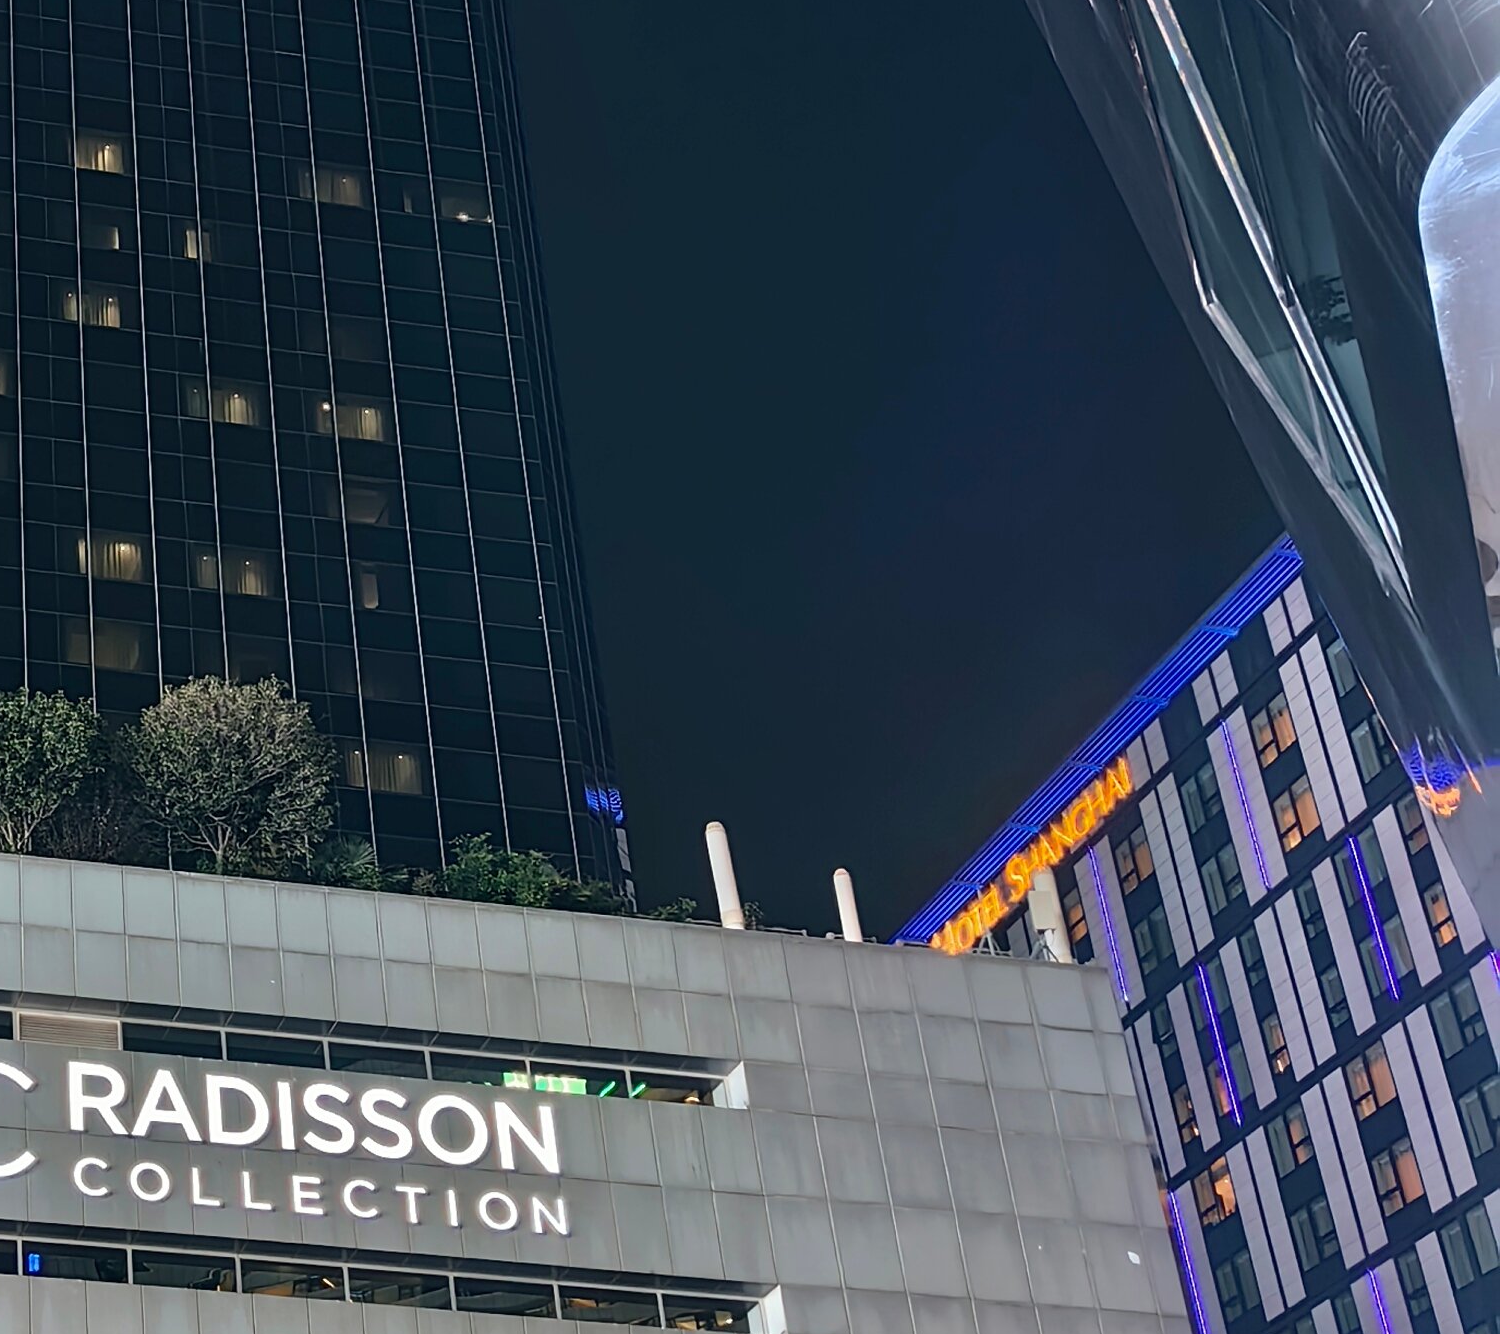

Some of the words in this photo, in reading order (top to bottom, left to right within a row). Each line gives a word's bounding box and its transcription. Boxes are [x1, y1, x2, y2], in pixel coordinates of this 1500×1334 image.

[1004, 756, 1135, 904] SHANGHAI
[67, 1060, 562, 1175] RADISSON
[72, 1156, 569, 1236] COLLECTION
